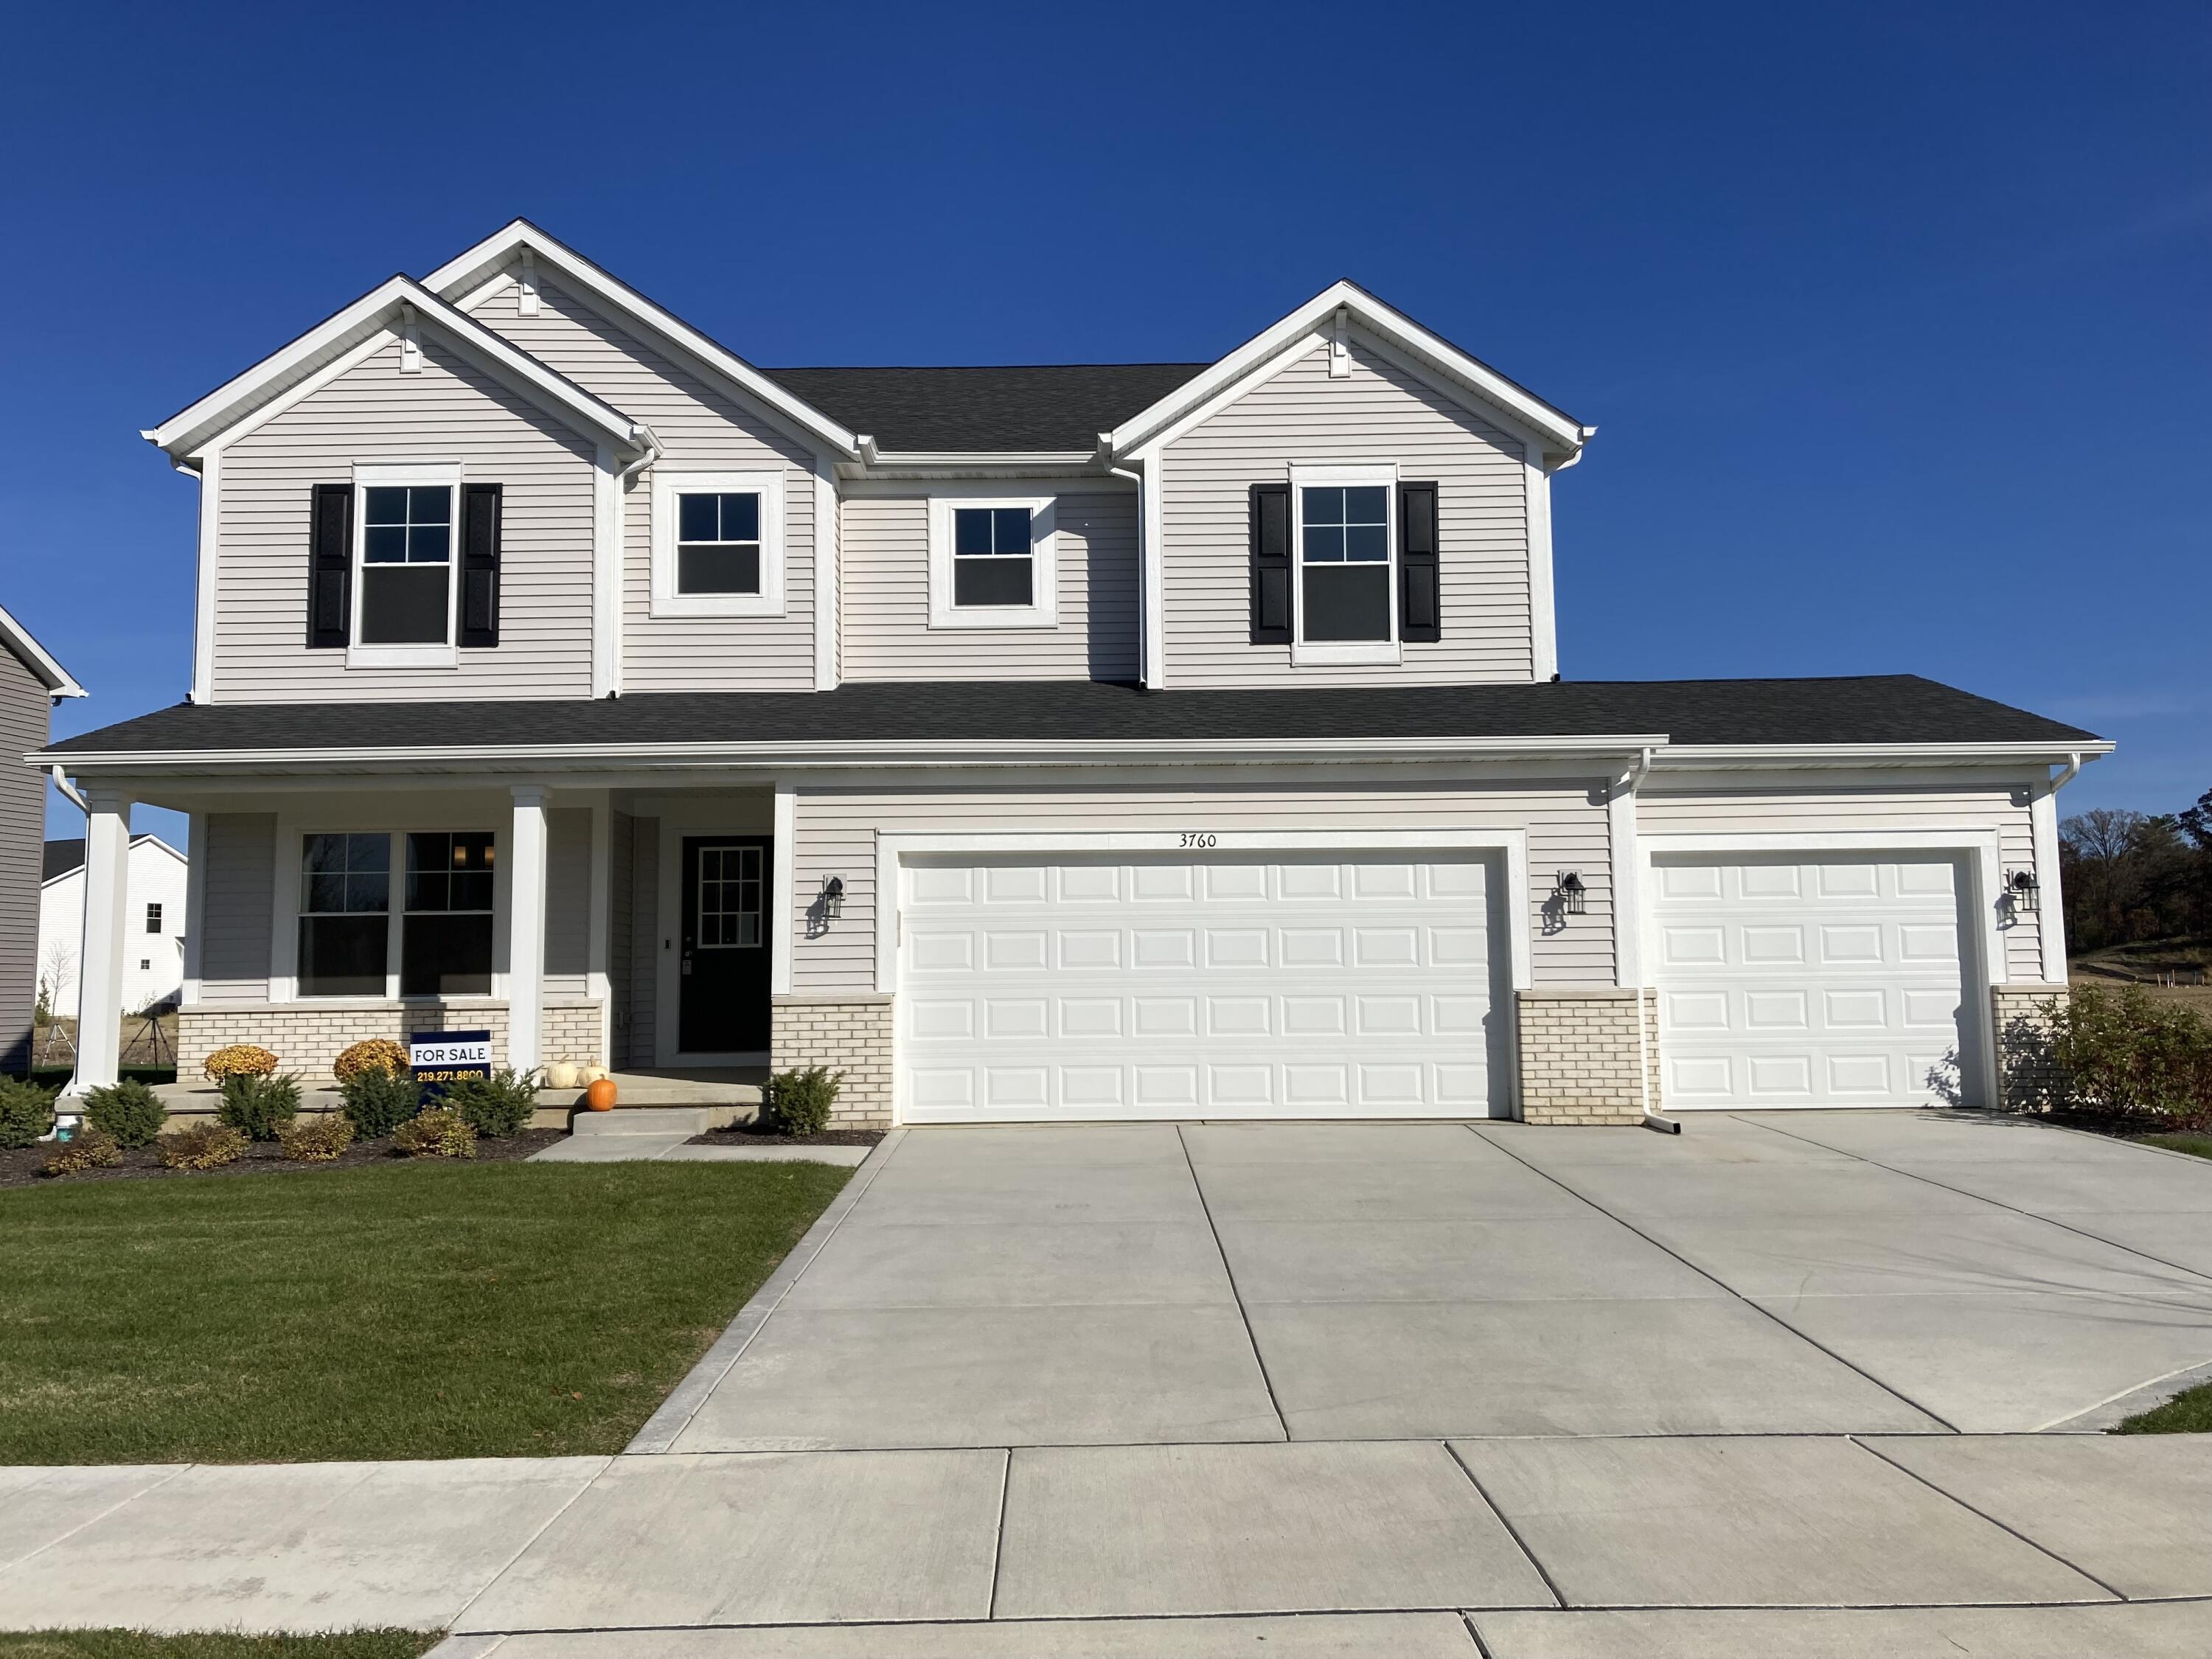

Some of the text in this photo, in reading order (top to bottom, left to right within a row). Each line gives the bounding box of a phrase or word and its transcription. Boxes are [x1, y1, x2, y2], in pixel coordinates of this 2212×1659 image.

[1179, 833, 1216, 848] 3760
[415, 1048, 486, 1062] FOR SALE
